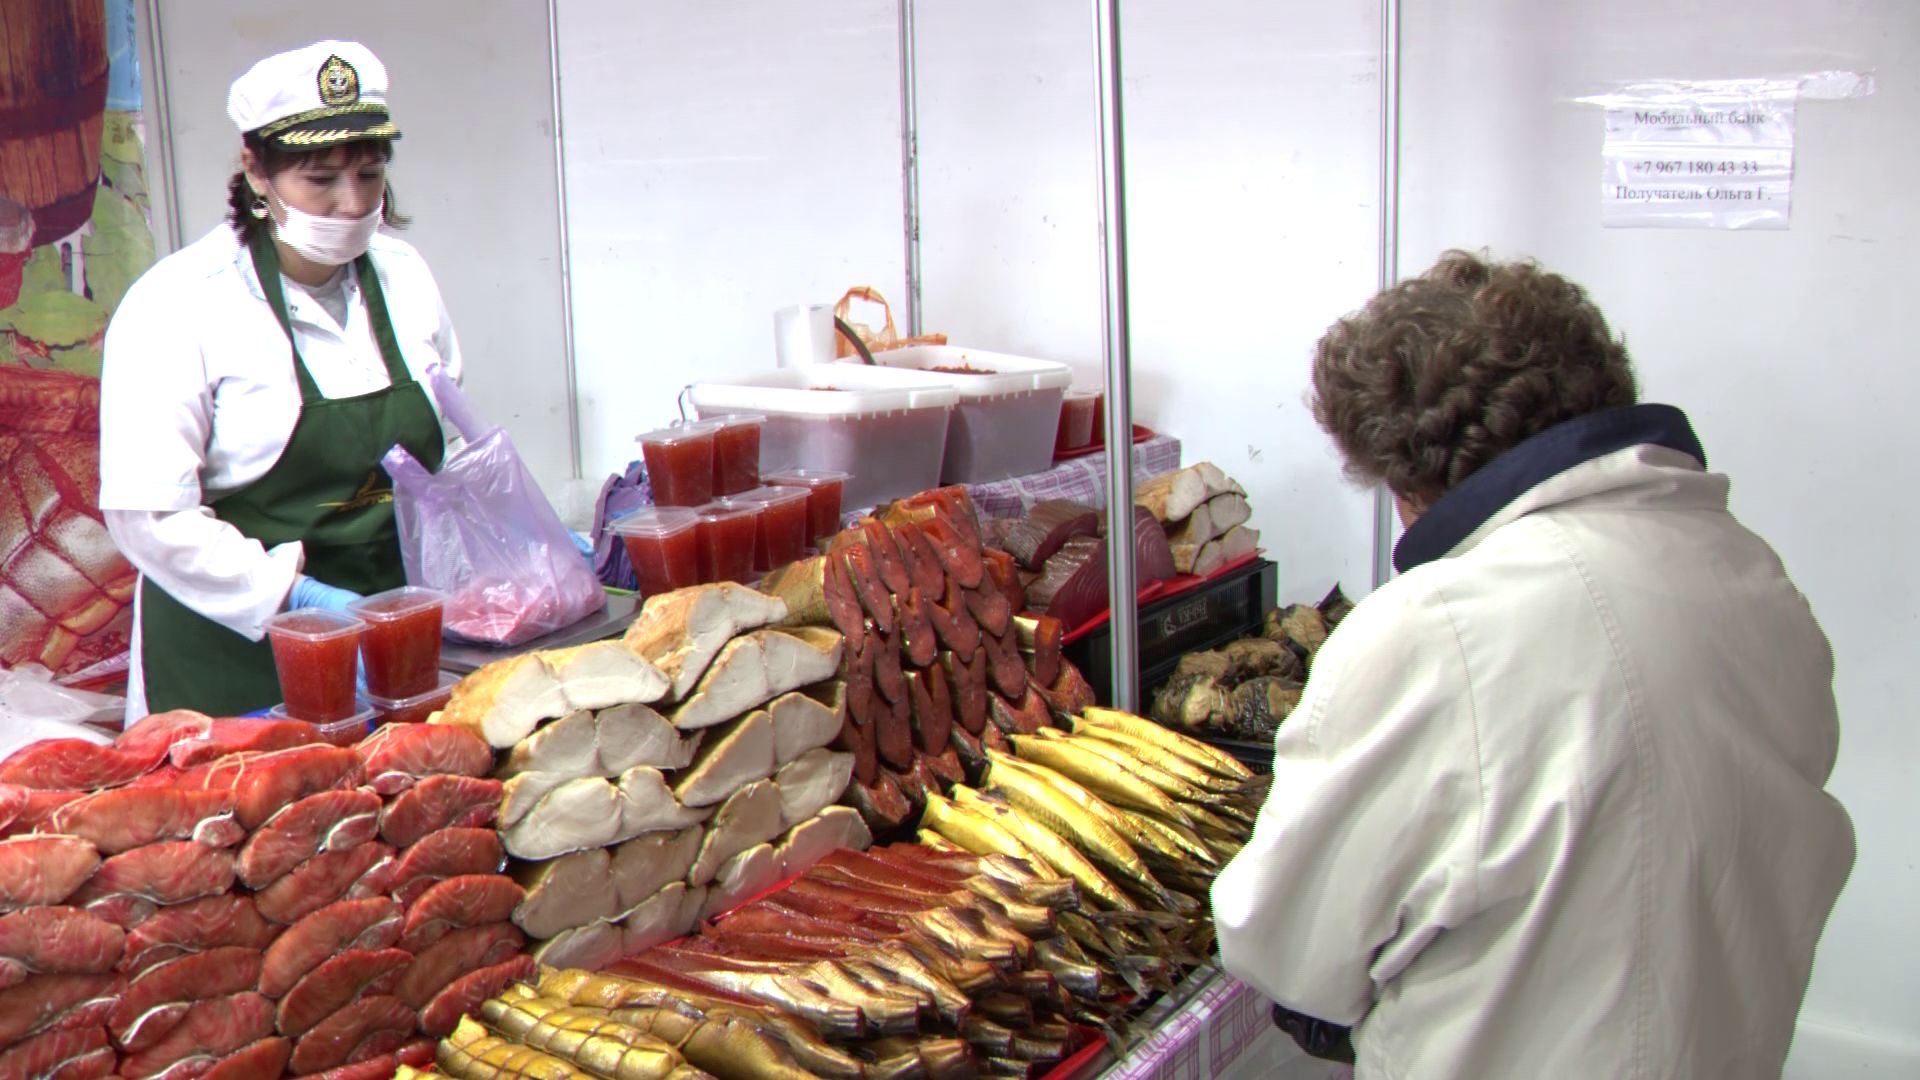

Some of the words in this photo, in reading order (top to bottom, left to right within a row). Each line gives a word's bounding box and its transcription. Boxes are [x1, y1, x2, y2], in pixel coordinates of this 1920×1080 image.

[1634, 111, 1724, 125] Мобильный
[1633, 161, 1652, 173] +7
[1656, 161, 1682, 174] 967
[1688, 161, 1713, 174] 180
[1717, 161, 1735, 174] 43
[1741, 161, 1759, 174] 33
[1615, 186, 1702, 202] Получатель
[1707, 187, 1752, 200] Ольга
[1757, 187, 1772, 200] Г.
